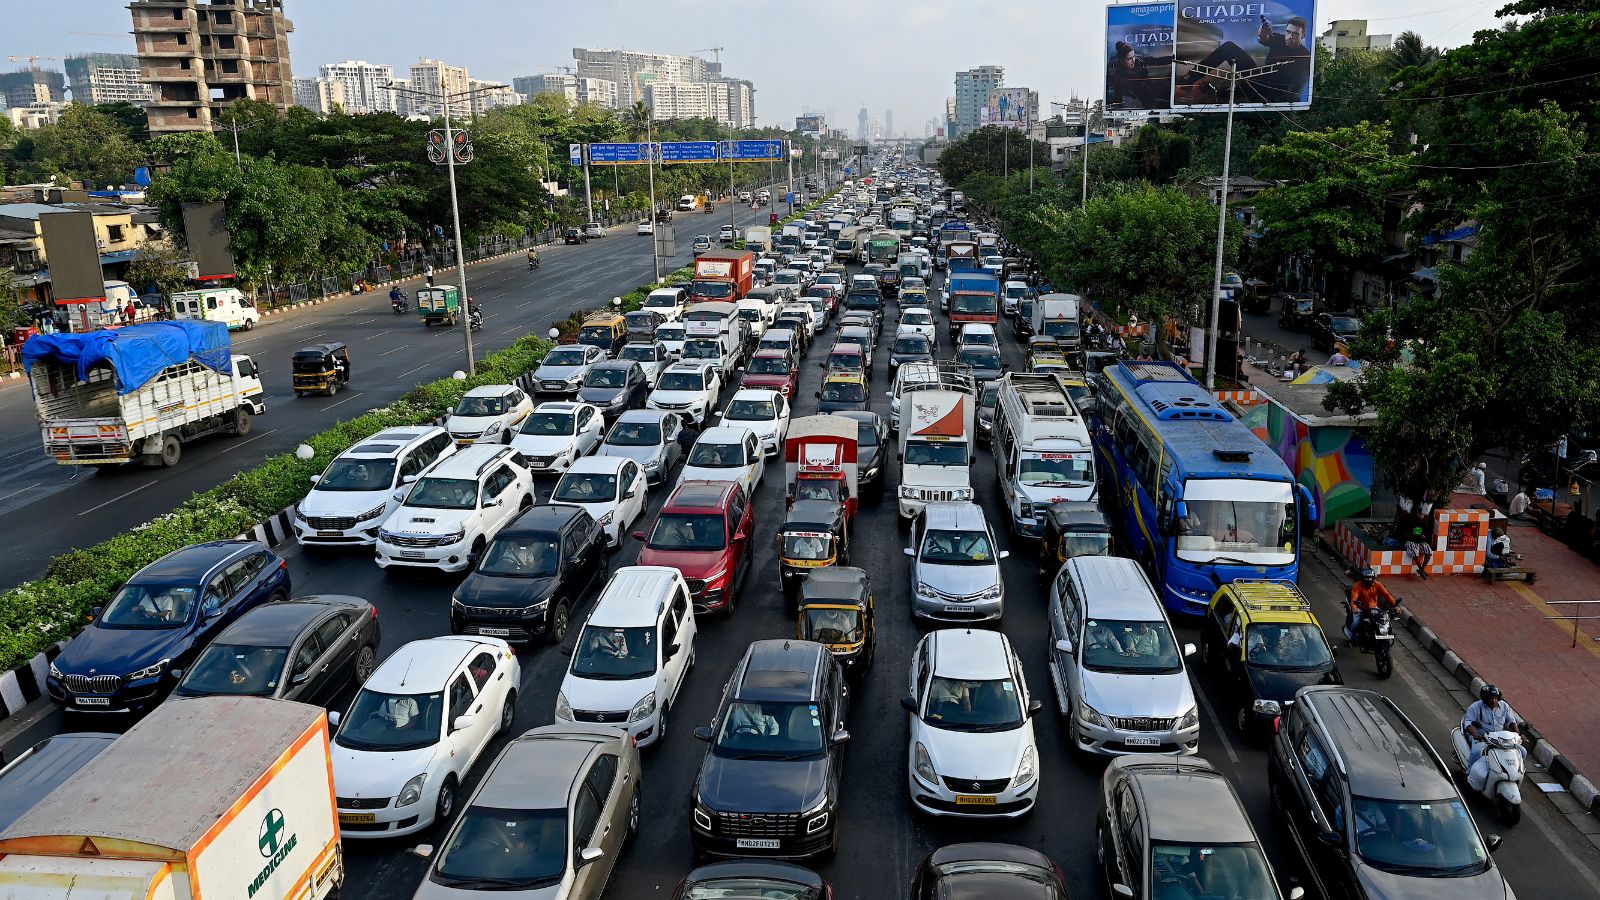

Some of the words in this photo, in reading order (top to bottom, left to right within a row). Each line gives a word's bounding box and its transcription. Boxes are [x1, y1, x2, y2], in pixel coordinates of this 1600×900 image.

[1130, 5, 1159, 14] amazon
[1181, 3, 1271, 19] CITADEL
[248, 833, 297, 899] MEDICINE
